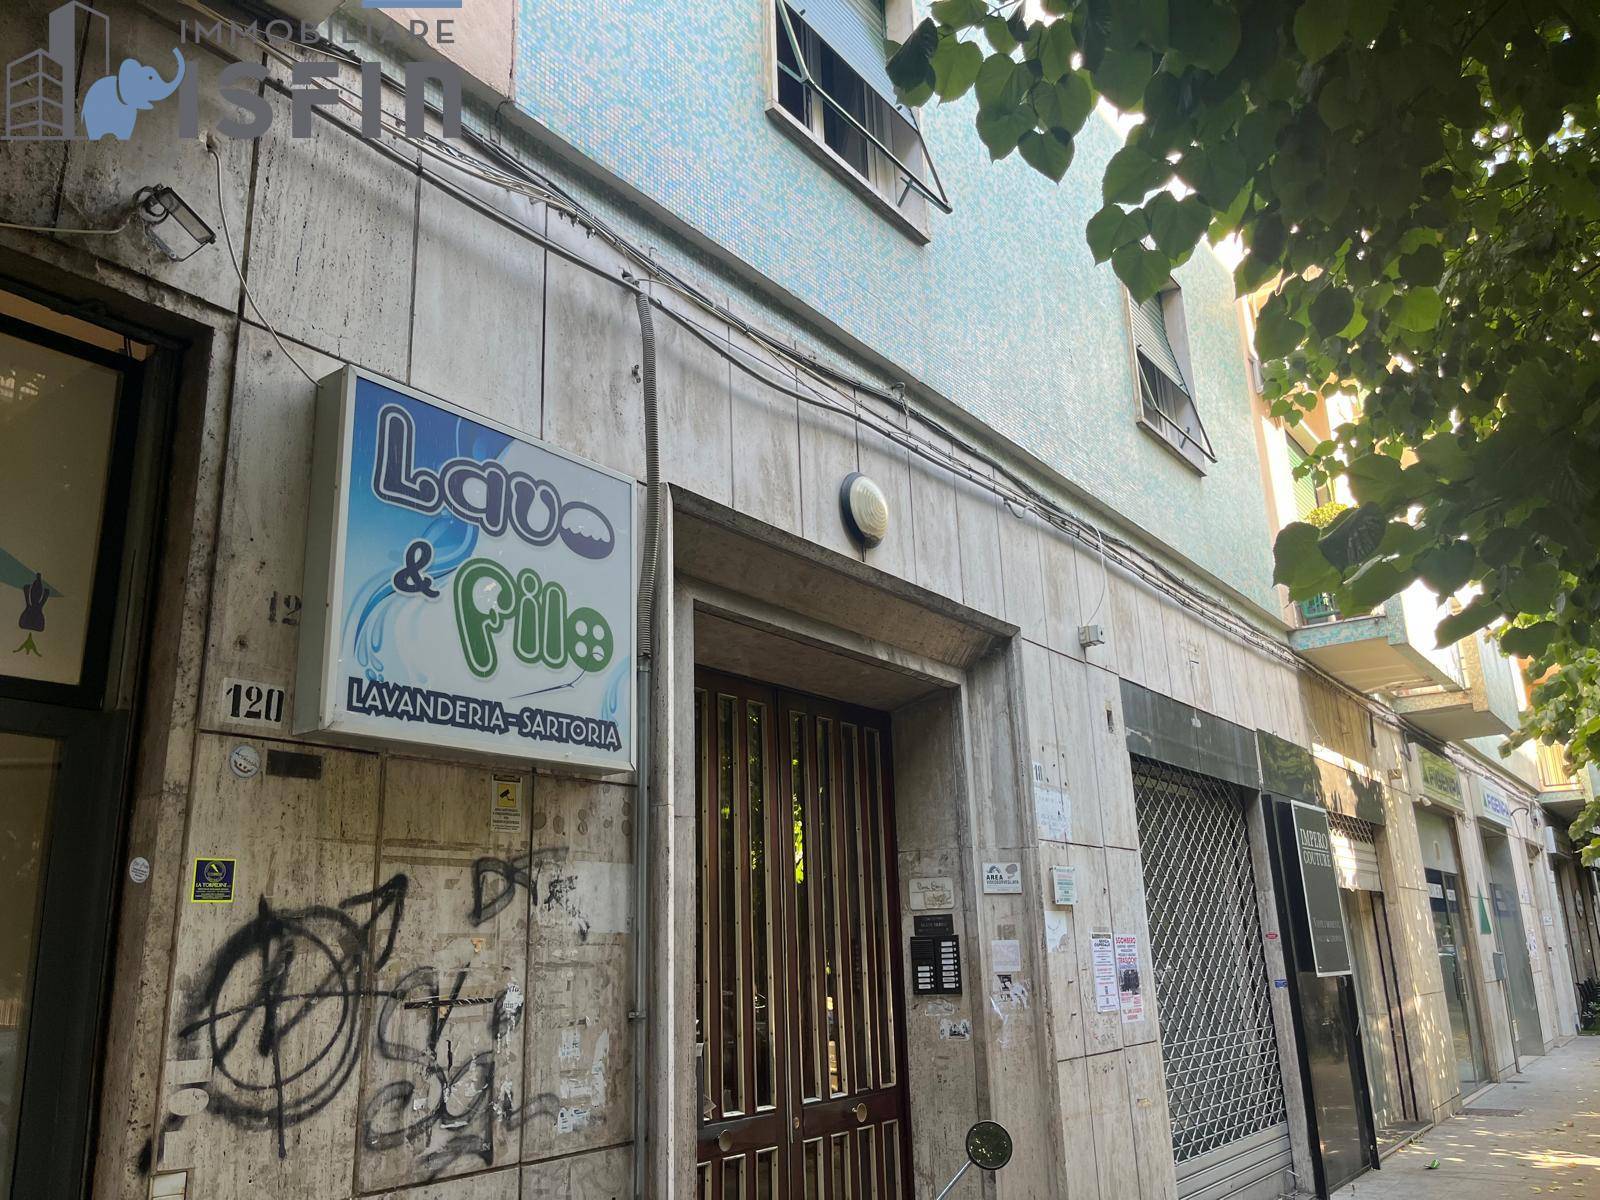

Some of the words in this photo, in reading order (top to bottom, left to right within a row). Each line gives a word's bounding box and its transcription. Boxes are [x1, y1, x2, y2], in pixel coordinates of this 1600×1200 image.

[393, 538, 440, 598] &
[226, 684, 285, 723] 120
[1299, 828, 1328, 849] IMPERO
[1303, 850, 1332, 867] COUTURE
